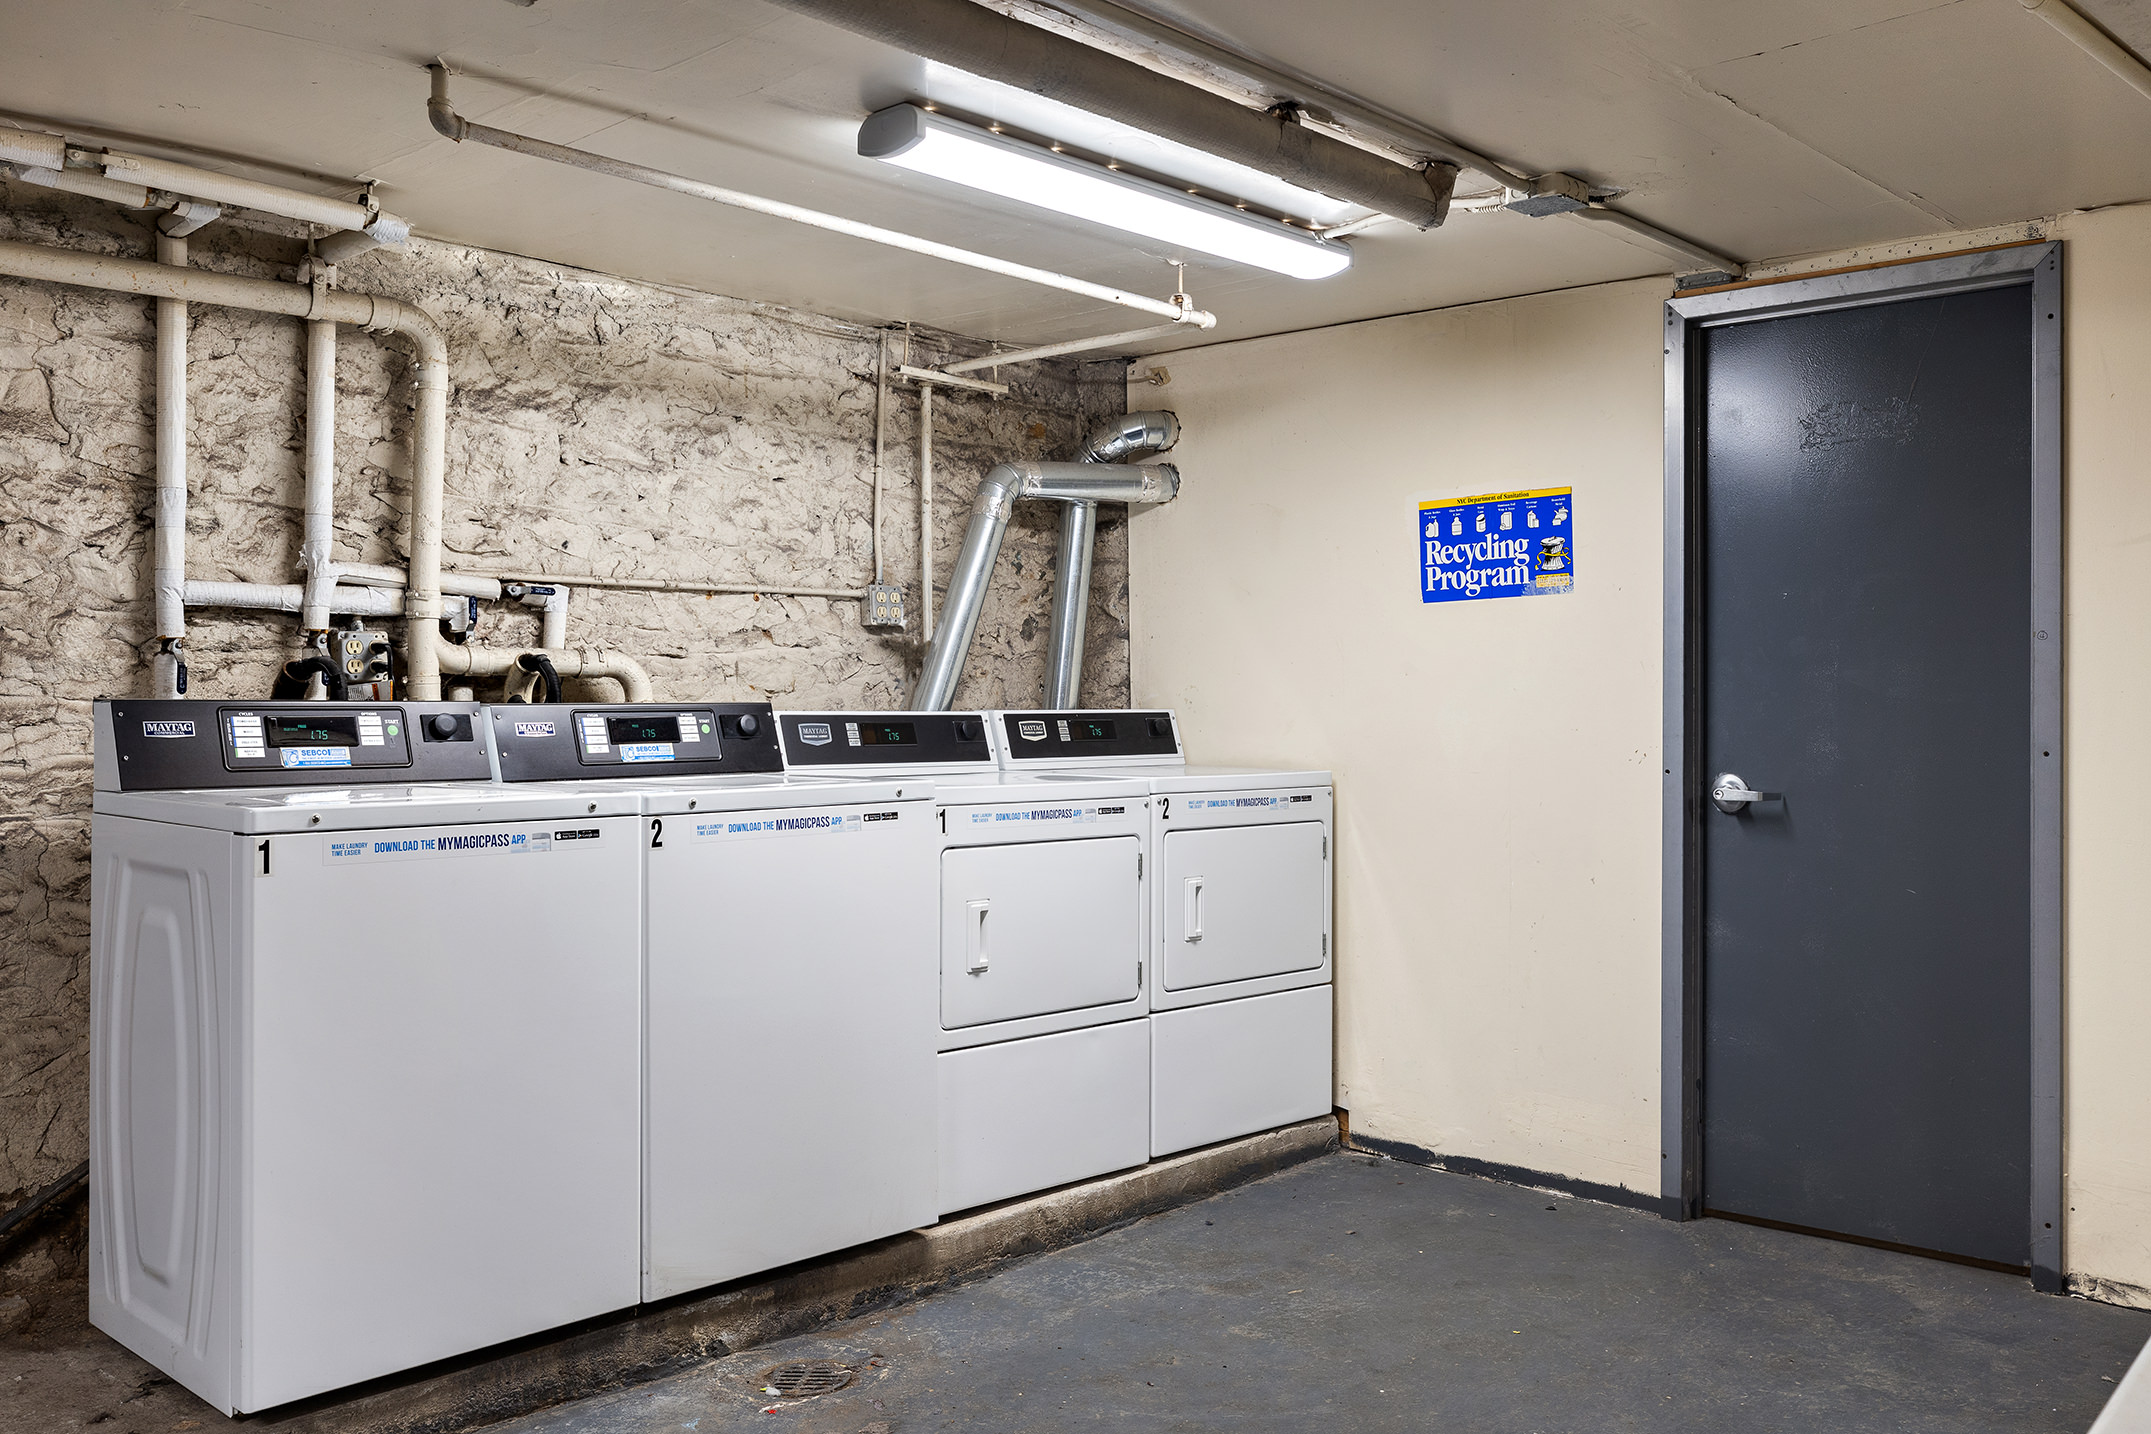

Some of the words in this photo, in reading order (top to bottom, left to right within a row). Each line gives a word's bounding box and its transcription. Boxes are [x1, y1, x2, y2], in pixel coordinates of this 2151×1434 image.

[1467, 494, 1496, 504] Department
[1503, 491, 1530, 500] Sanitation
[1424, 532, 1530, 570] Recycling
[1425, 565, 1531, 597] Program
[146, 723, 192, 732] MAYTAG
[518, 723, 553, 732] MAYTAG
[802, 727, 828, 735] MAYTAG
[1022, 724, 1043, 732] MAYTAG
[301, 748, 328, 757] SEBCO
[1162, 797, 1170, 820] 2
[1207, 799, 1228, 808] DOWNLOAD
[1235, 796, 1270, 807] MYMAGICPASS
[939, 808, 946, 834] 1
[995, 812, 1021, 821] DOWNLOAD
[1021, 811, 1030, 820] THE
[1030, 808, 1073, 820] MYMAGICPASS
[1073, 809, 1082, 817] APP
[728, 821, 762, 833] DOWNLOAD
[762, 820, 775, 830] THE
[775, 815, 831, 831] MYMAGICPASS
[831, 816, 842, 826] APP
[650, 818, 663, 848] 2
[374, 840, 419, 854] DOWNLOAD
[420, 839, 436, 850] THE
[437, 833, 510, 851] MYMAGICPASS
[511, 834, 527, 845] APP
[258, 839, 270, 875] 1
